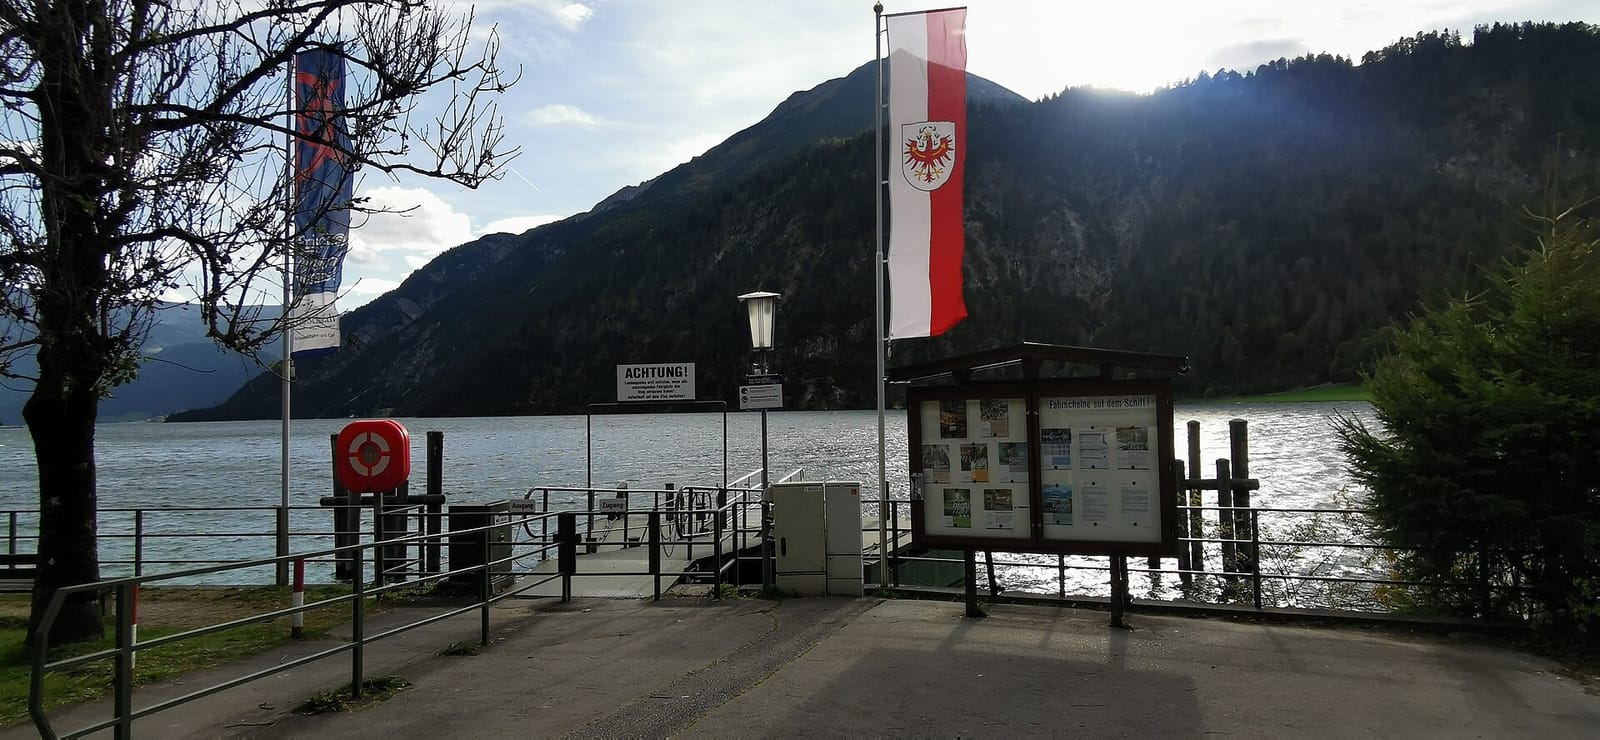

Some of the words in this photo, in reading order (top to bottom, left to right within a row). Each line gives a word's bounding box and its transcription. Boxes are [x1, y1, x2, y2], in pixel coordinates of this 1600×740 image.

[625, 366, 688, 378] ACHTUNG!
[1049, 399, 1090, 409] Fahrscheine
[1093, 399, 1105, 408] auf
[1107, 398, 1122, 408] dem
[512, 502, 534, 510] Ausgang
[601, 501, 624, 509] Zugang
